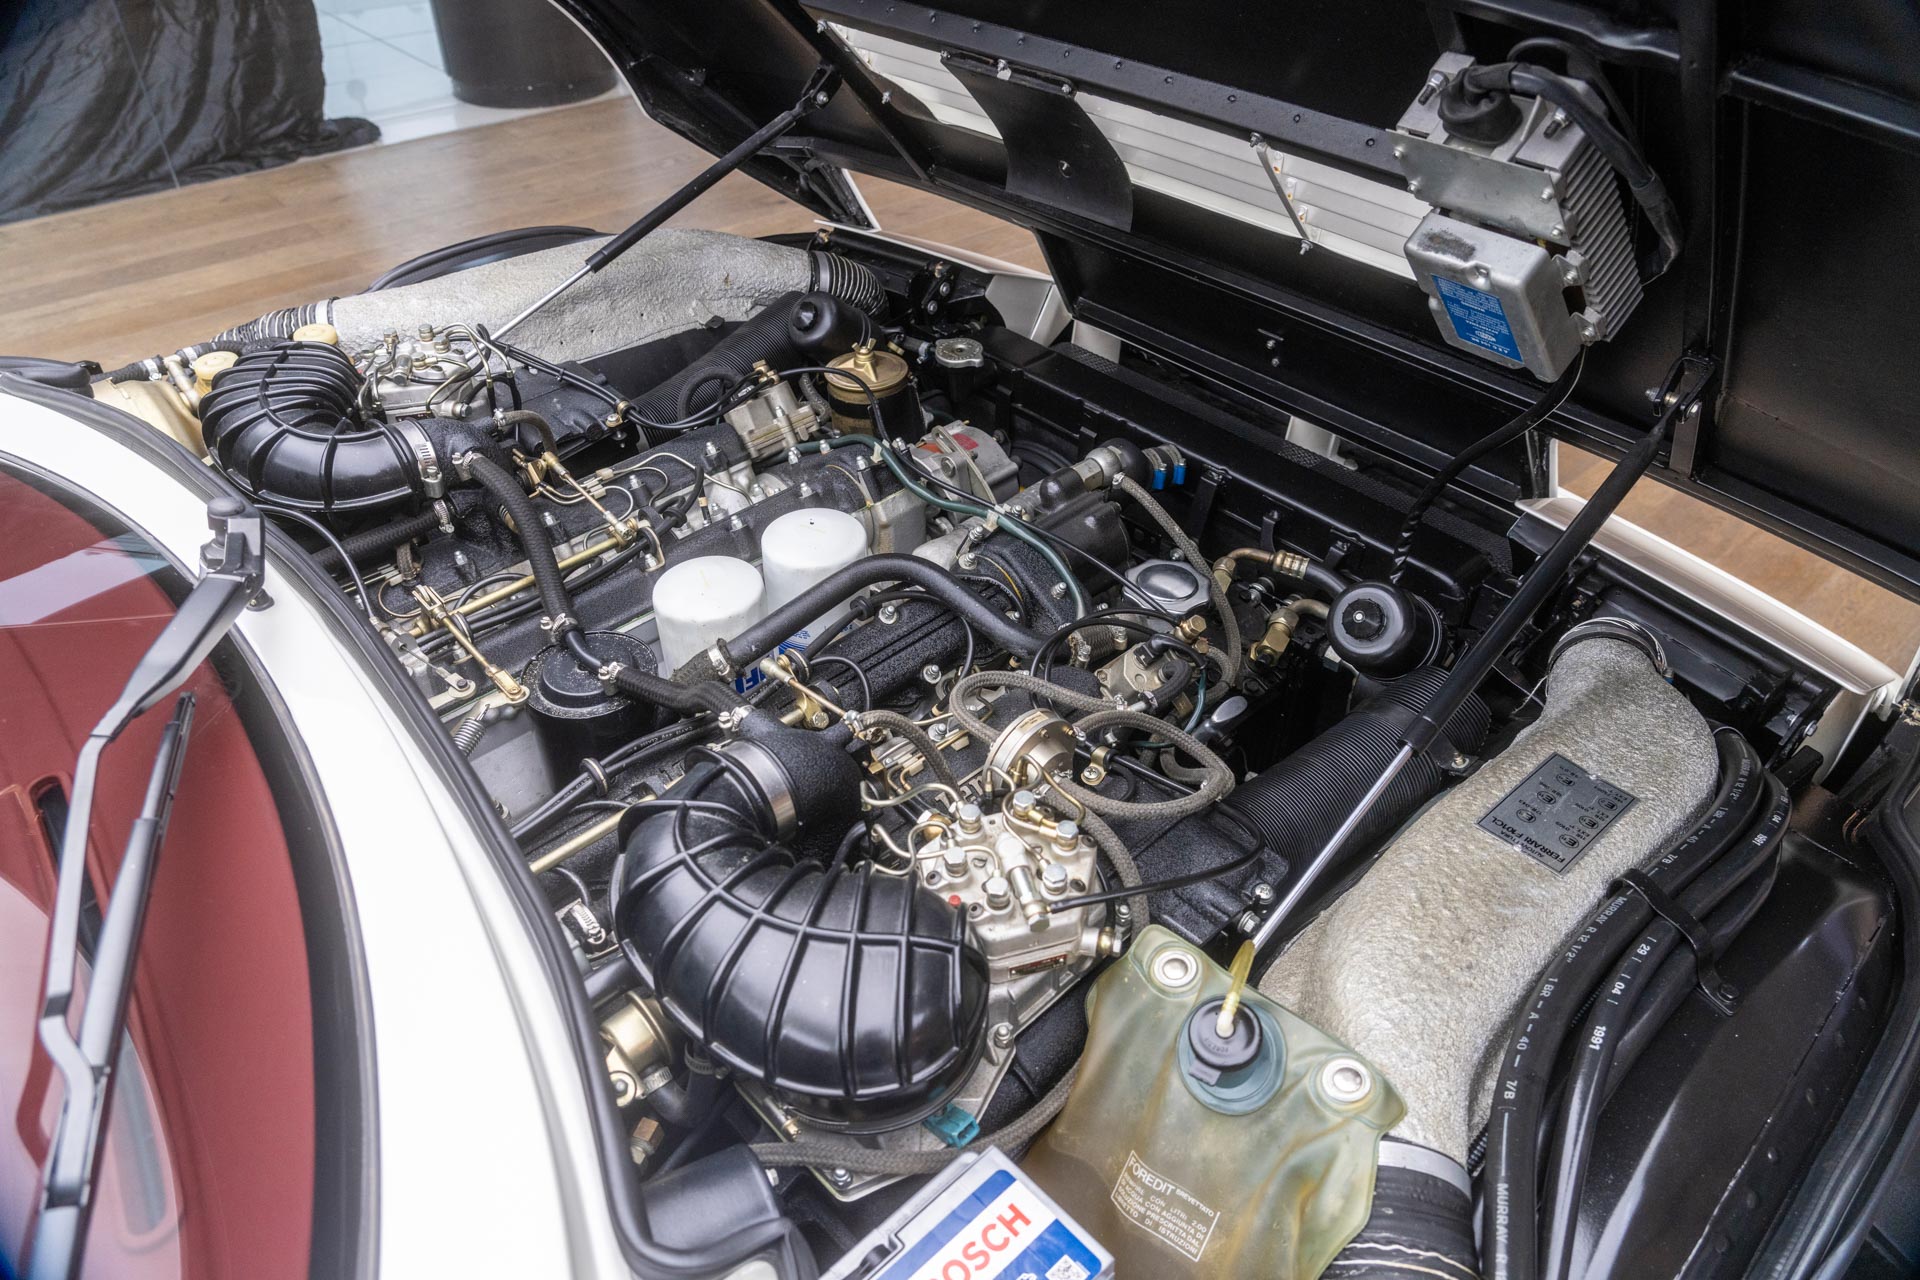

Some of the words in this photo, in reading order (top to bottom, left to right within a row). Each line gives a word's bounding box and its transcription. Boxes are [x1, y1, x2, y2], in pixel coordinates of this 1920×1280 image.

[1489, 816, 1524, 838] F101CL
[1523, 836, 1566, 863] FERRARI
[1596, 896, 1627, 925] MURRAY
[1577, 934, 1590, 944] 12
[1586, 926, 1598, 934] R
[1637, 944, 1650, 956] 29
[1611, 981, 1625, 996] 04
[1516, 1035, 1529, 1050] 40
[1588, 1026, 1606, 1050] 1991
[1128, 1156, 1175, 1196] FOREDIT
[1175, 1188, 1214, 1217] BREVETTATO
[1117, 1186, 1145, 1213] SOLUZIONE
[1145, 1209, 1187, 1238] PRESCRITTA
[1186, 1235, 1201, 1247] DAL
[1144, 1200, 1160, 1213] CON
[1160, 1210, 1195, 1234] AGGIUNTA
[1195, 1232, 1204, 1240] DI
[1149, 1194, 1166, 1208] CON
[1190, 1219, 1207, 1233] 2.00
[1496, 1182, 1508, 1244] MURRAY
[930, 1203, 1032, 1280] OSCH
[1157, 1226, 1197, 1254] ISTRUZIONI
